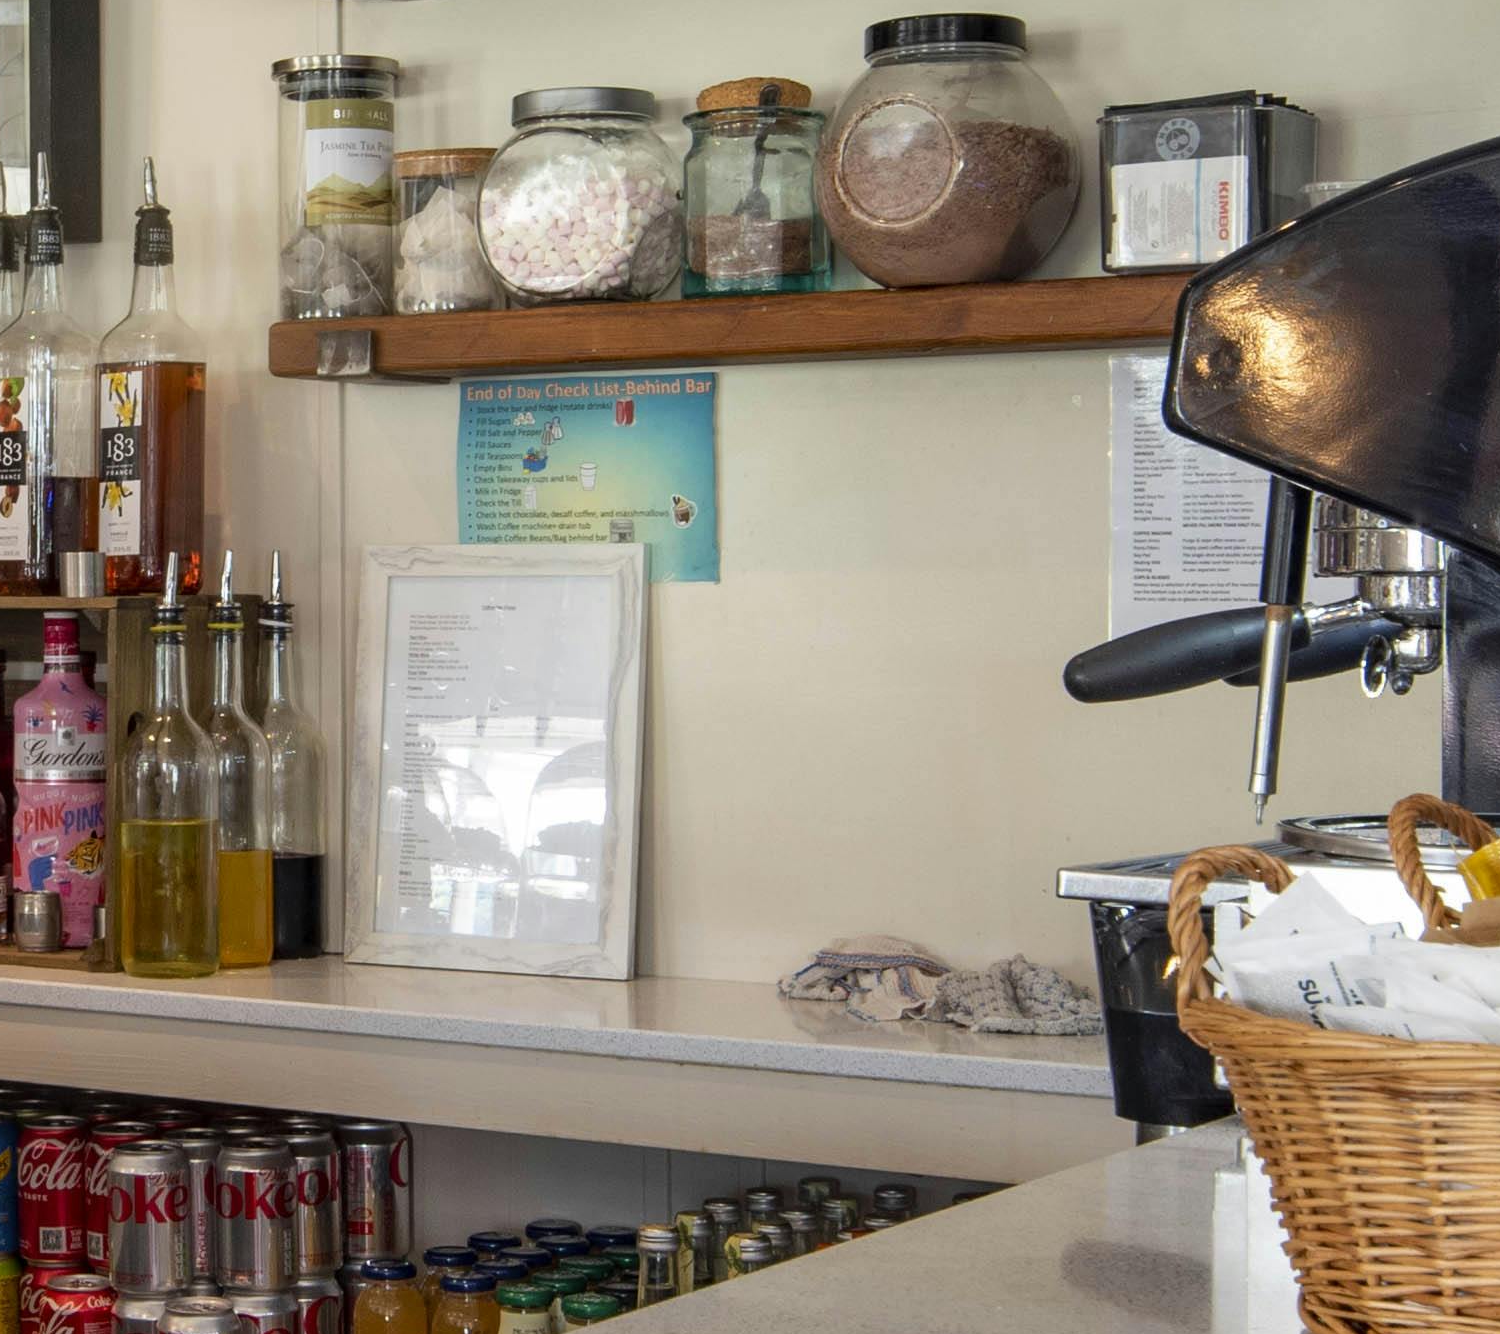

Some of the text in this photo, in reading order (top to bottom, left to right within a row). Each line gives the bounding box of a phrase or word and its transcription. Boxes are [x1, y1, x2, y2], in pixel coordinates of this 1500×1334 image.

[320, 141, 375, 153] JASMINE TEA
[1219, 181, 1229, 240] KIMBO
[38, 234, 60, 243] 1883
[149, 234, 171, 242] 1883
[467, 386, 493, 401] End
[498, 385, 513, 399] of
[517, 385, 541, 401] Day
[545, 383, 590, 398] Check
[686, 379, 712, 394] Bar
[524, 404, 537, 412] and
[538, 403, 558, 413] fridge
[107, 433, 134, 462] 1883
[487, 441, 512, 449] Sauces
[496, 475, 530, 485] Takeaway
[475, 487, 490, 495] Milk
[476, 499, 495, 507] Check
[498, 499, 510, 507] the
[600, 509, 614, 517] and
[498, 522, 520, 530] Coffee
[477, 534, 503, 543] Enough
[23, 738, 106, 767] Gordon's
[23, 802, 65, 834] PINK
[109, 1175, 189, 1224] oke
[215, 1172, 296, 1220] oke
